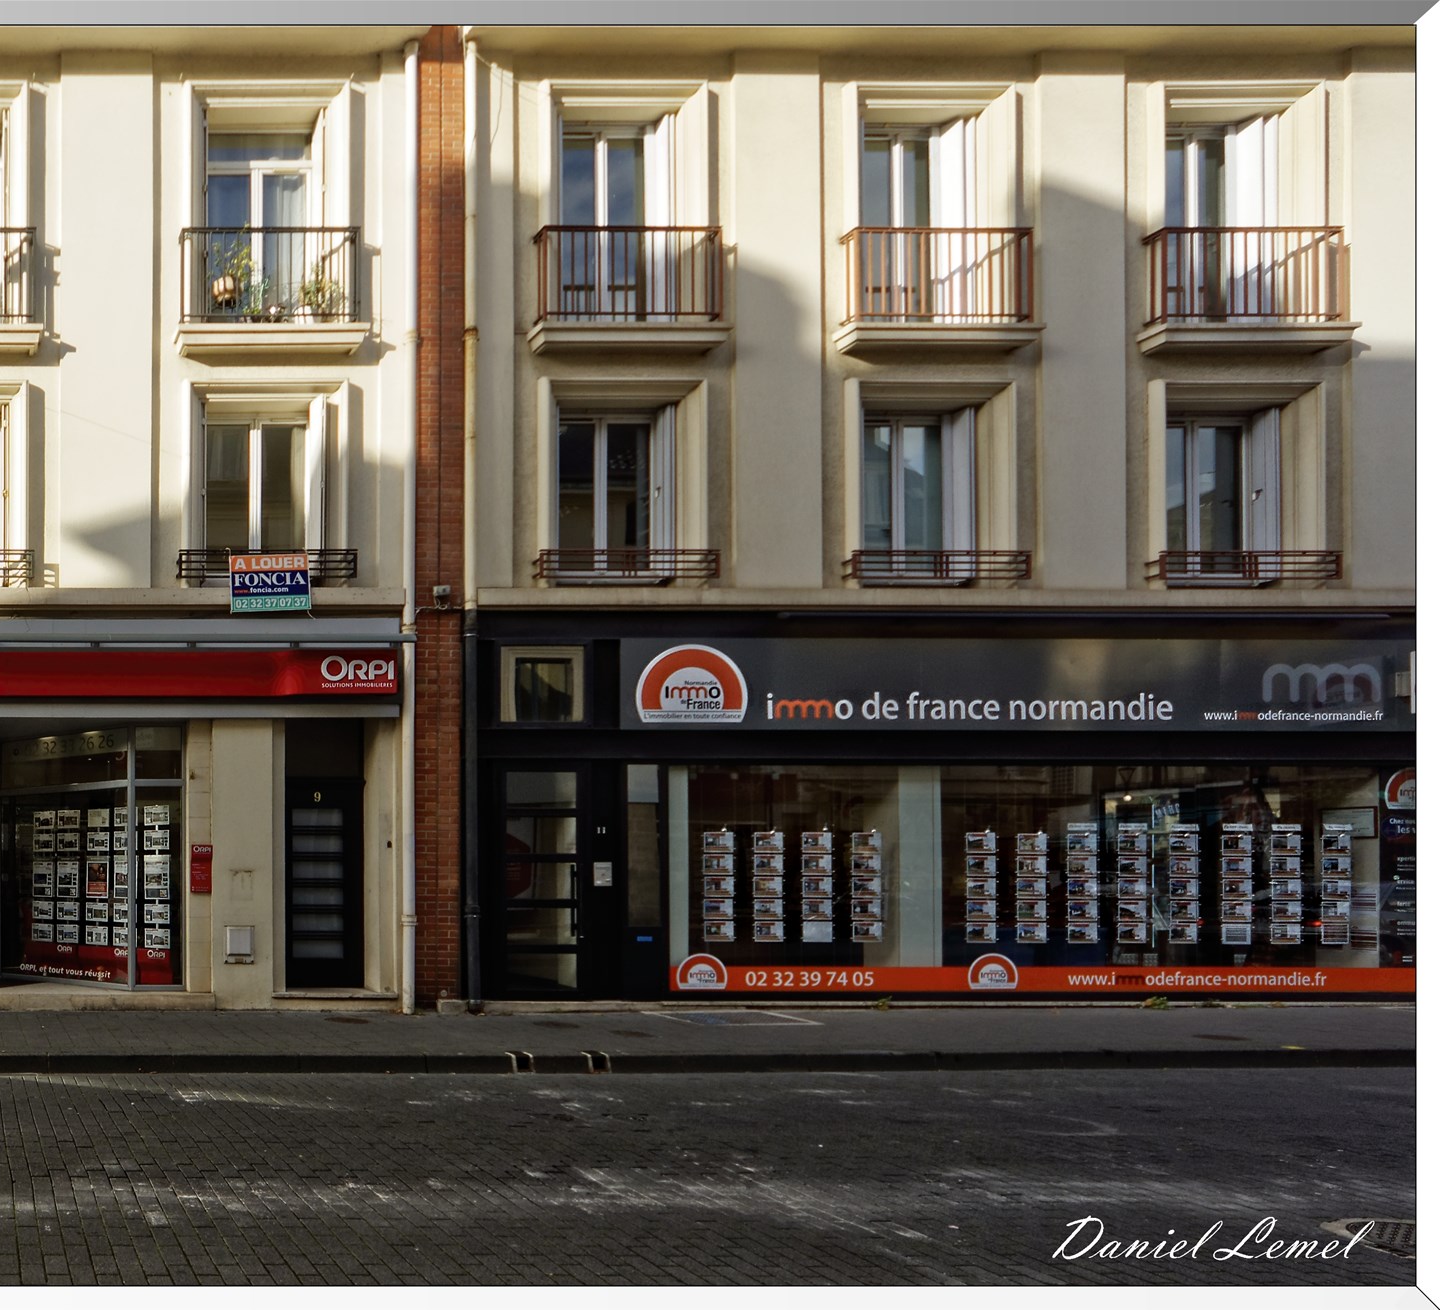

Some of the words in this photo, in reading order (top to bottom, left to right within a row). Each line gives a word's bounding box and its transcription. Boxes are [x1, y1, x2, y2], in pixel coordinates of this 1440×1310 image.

[234, 558, 246, 570] A
[251, 556, 305, 569] LOUER
[234, 572, 307, 587] FONCIA
[235, 600, 248, 608] 02
[250, 599, 263, 608] 32
[265, 598, 277, 608] 37
[279, 598, 292, 607] 07
[294, 598, 306, 607] 37
[320, 655, 395, 682] ORPI
[686, 699, 720, 710] France
[766, 692, 854, 720] immo
[861, 692, 899, 720] de
[906, 691, 1001, 720] france
[1009, 692, 1174, 720] normandie
[42, 740, 57, 754] 32
[98, 734, 114, 749] 26
[314, 792, 322, 802] 9
[1398, 825, 1410, 834] les
[56, 944, 72, 952] ORPI
[147, 950, 166, 958] ORPI
[20, 963, 37, 972] ORPI,
[48, 966, 64, 974] tout
[66, 968, 83, 976] vous
[745, 971, 768, 987] 02
[772, 971, 794, 987] 32
[799, 971, 822, 987] 39
[826, 971, 848, 987] 74
[852, 971, 874, 987] 05
